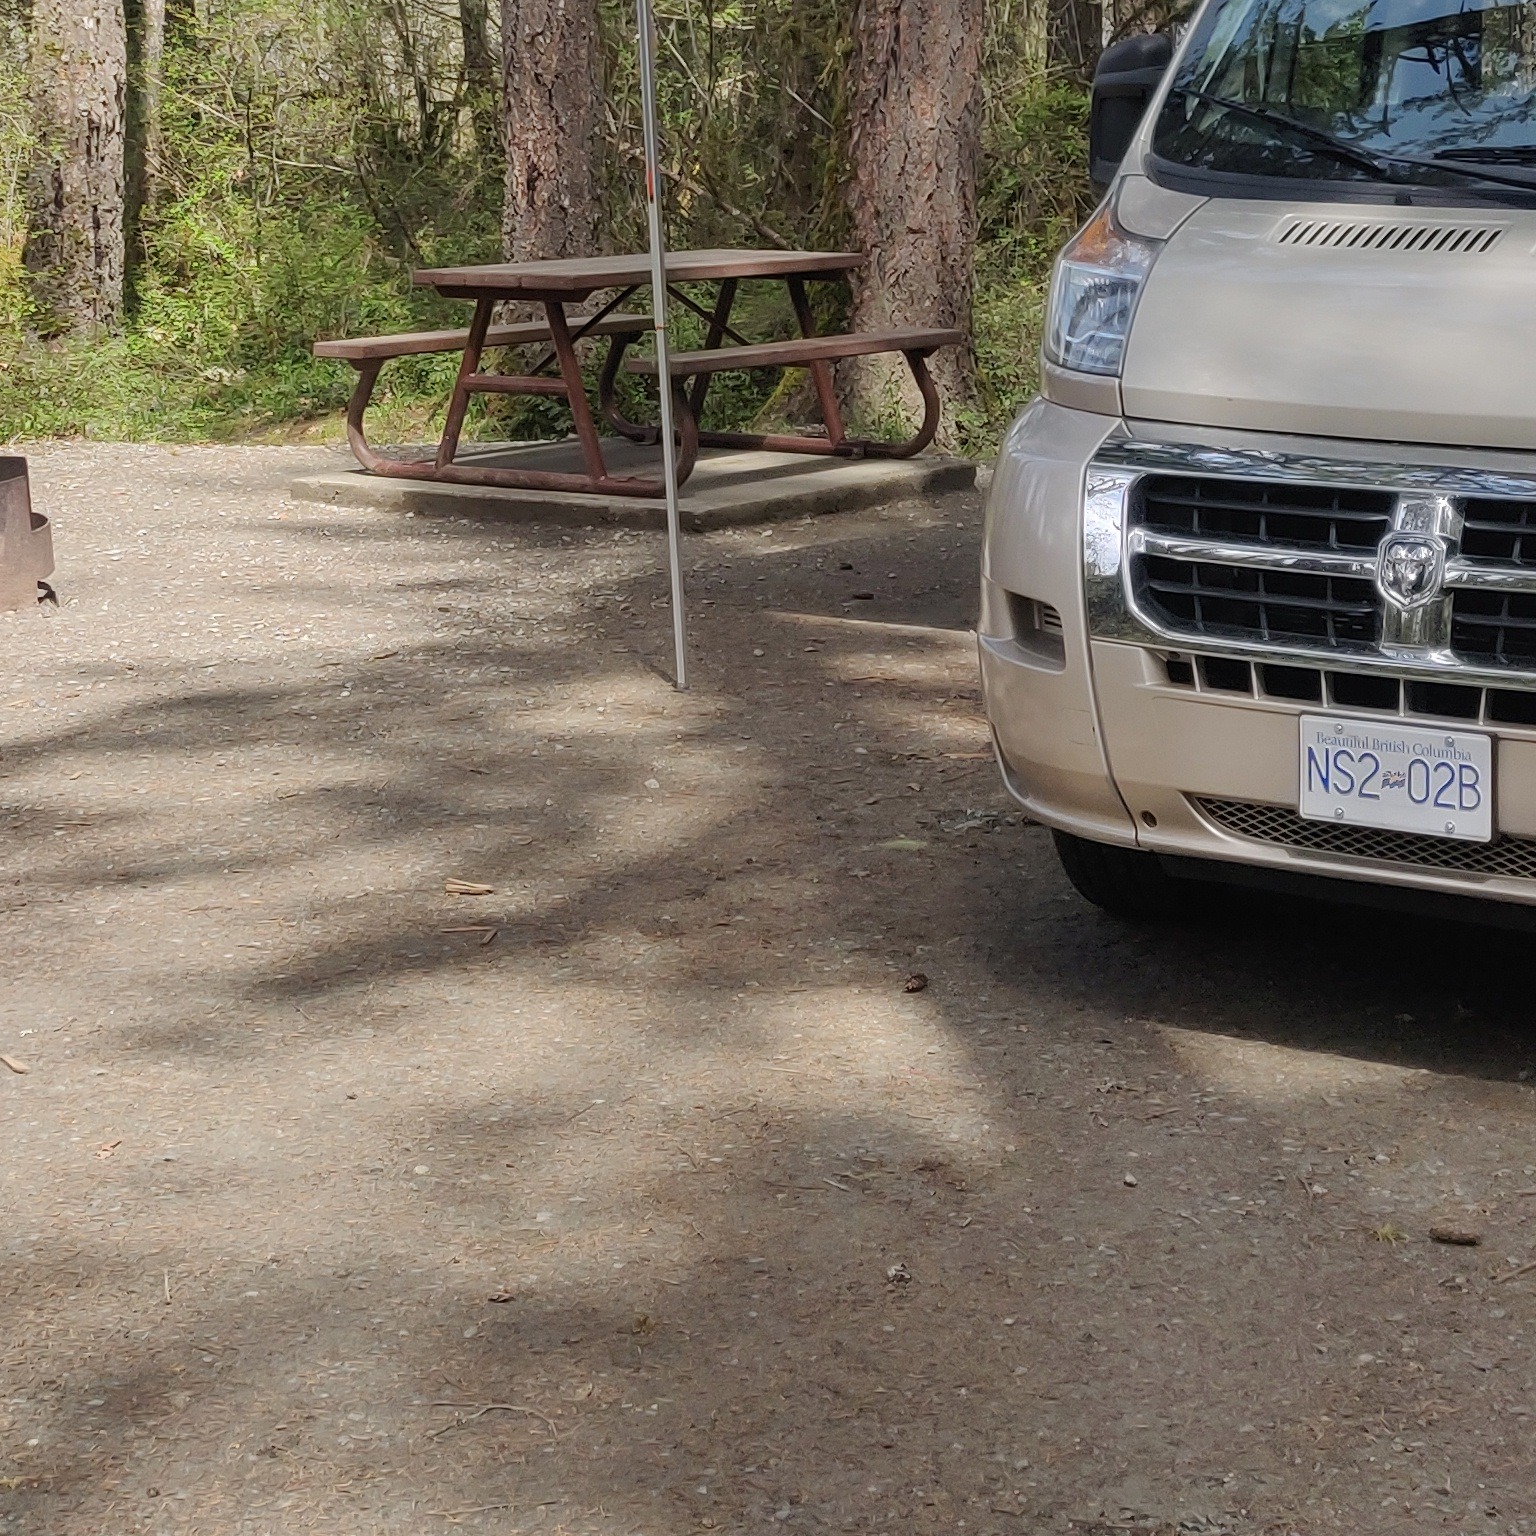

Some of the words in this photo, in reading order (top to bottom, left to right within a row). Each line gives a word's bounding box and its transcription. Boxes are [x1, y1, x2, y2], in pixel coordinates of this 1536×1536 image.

[1316, 731, 1369, 750] Beautiful
[1372, 738, 1411, 755] British
[1413, 743, 1473, 762] Columbia
[1307, 746, 1381, 801] NS2
